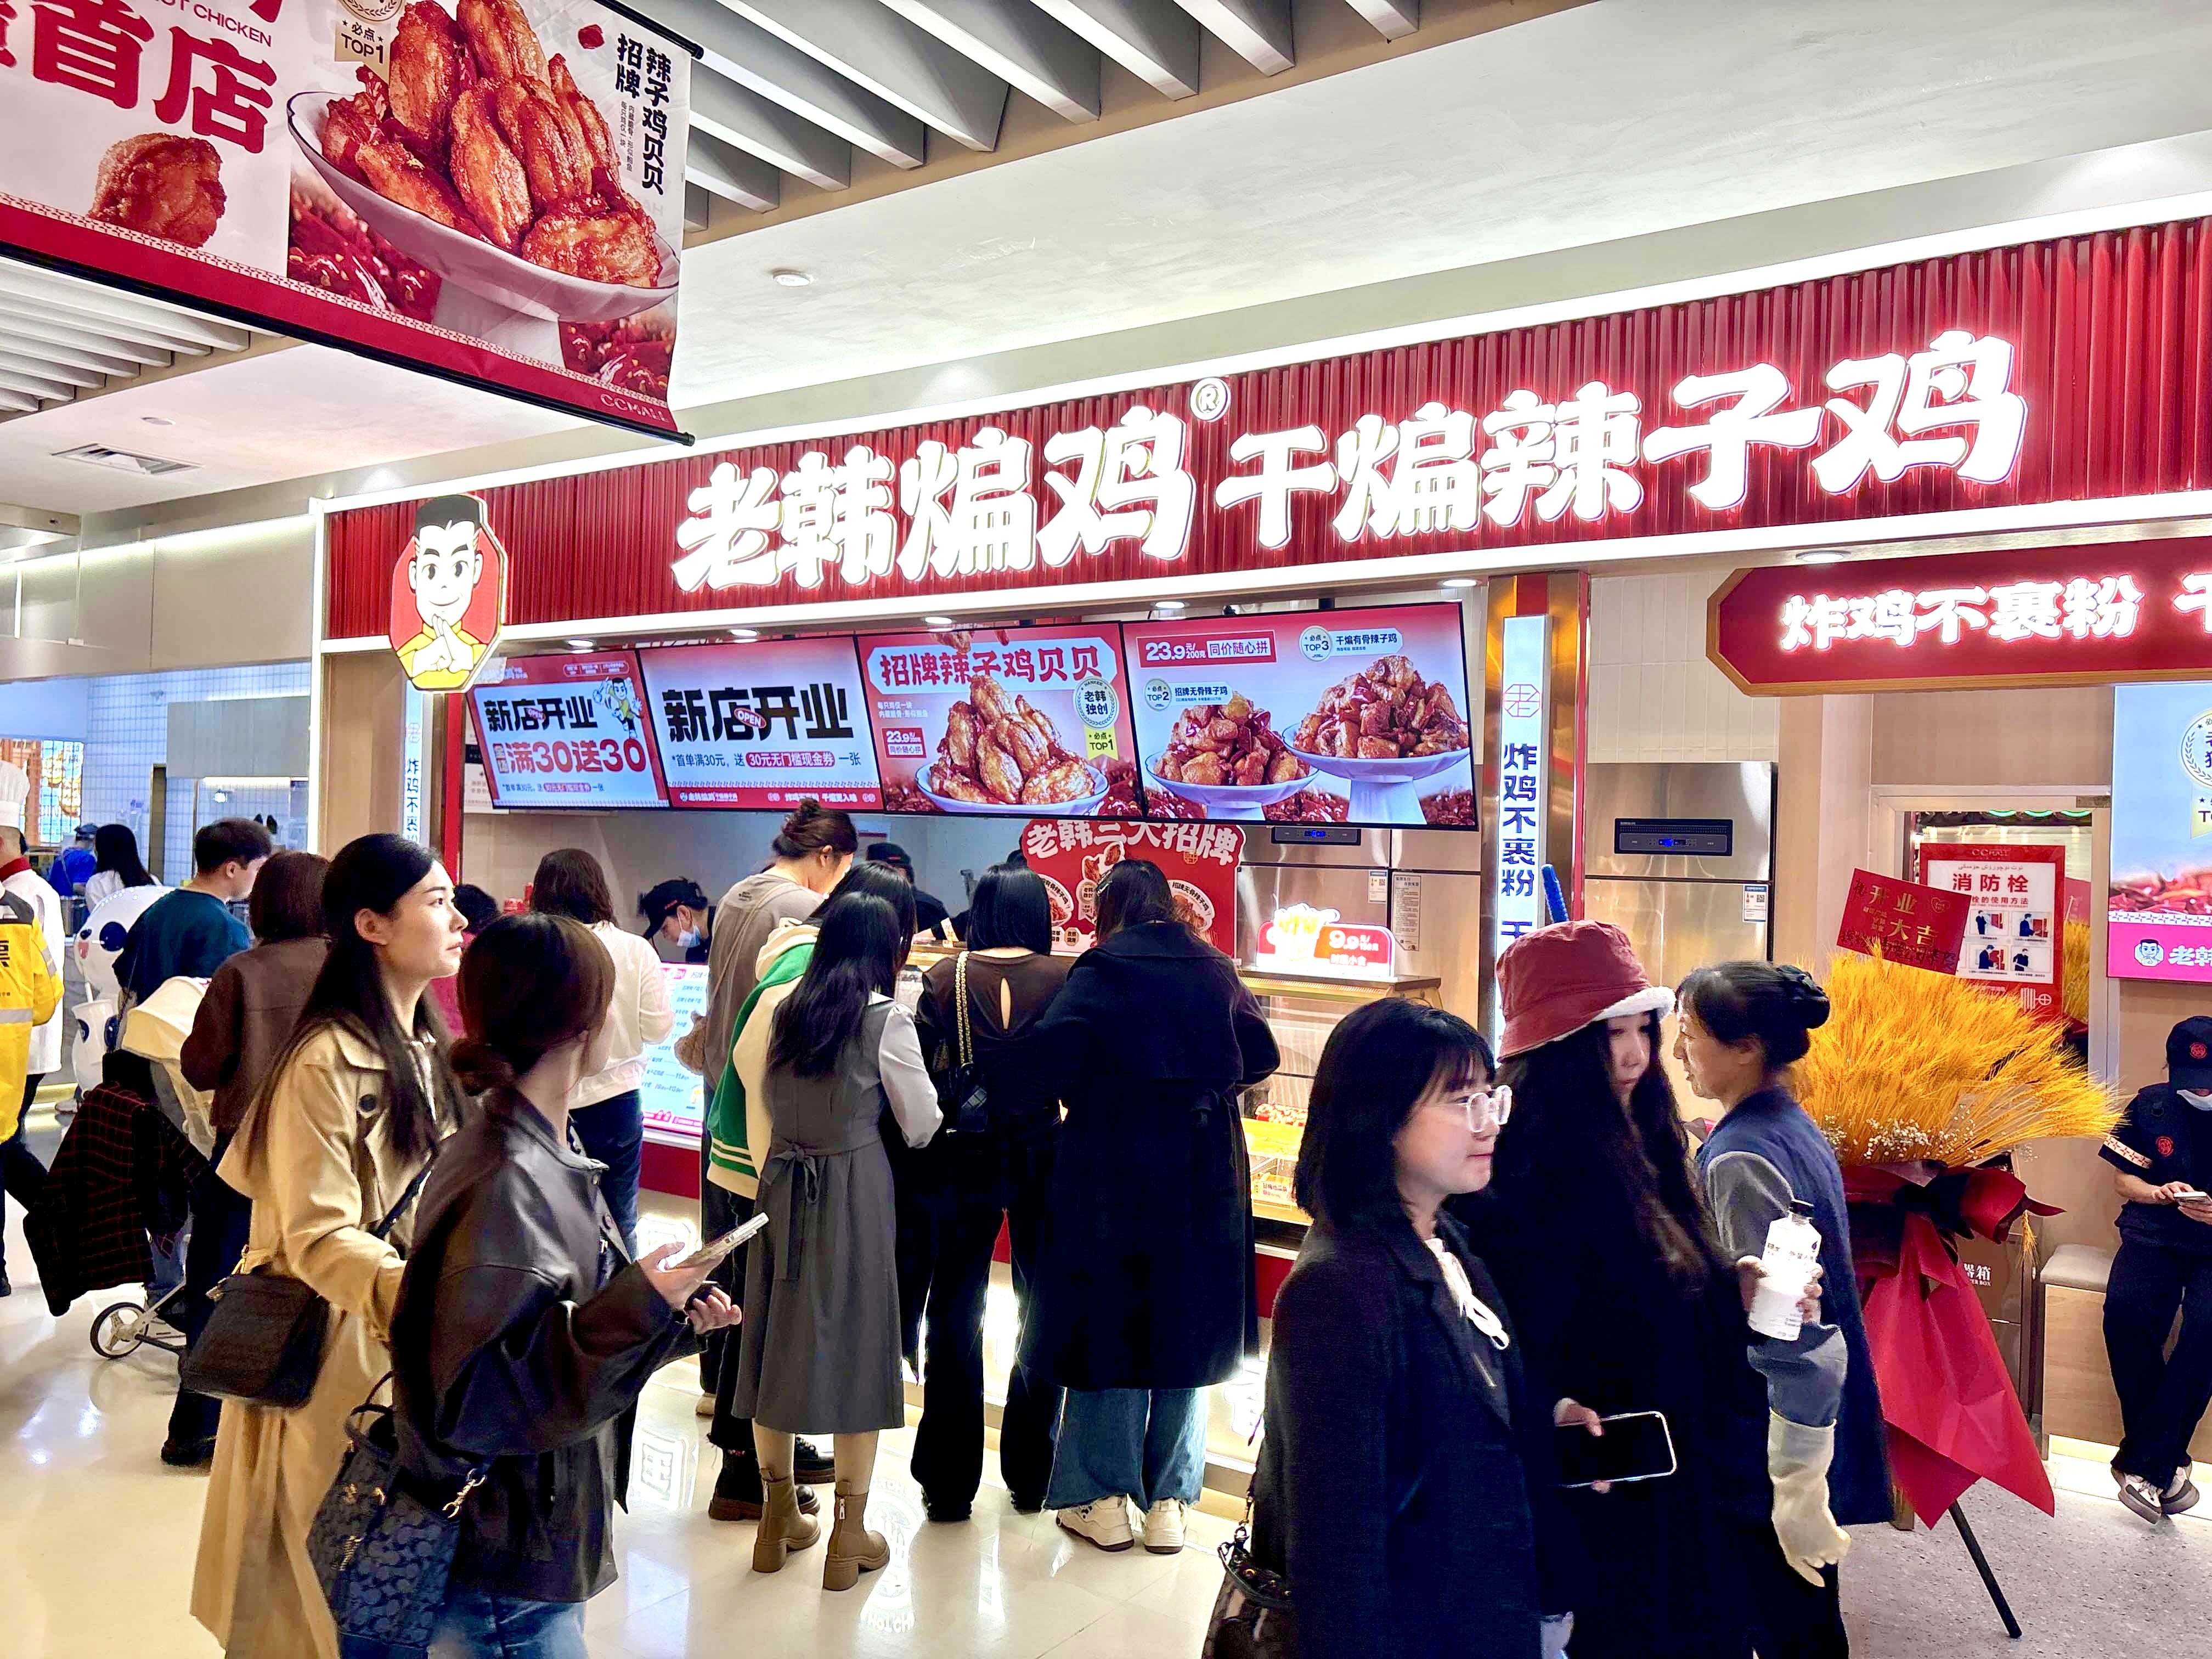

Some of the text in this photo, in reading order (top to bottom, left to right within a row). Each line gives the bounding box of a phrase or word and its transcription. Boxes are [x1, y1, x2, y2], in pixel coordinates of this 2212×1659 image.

[193, 3, 272, 47] CHICKEN
[352, 21, 375, 42] 必点
[341, 33, 384, 64] TOP1
[0, 0, 276, 154] 首店
[616, 33, 643, 98] 招牌
[642, 47, 671, 195] 辣子鸡贝贝
[600, 394, 669, 422] CCMALL
[1215, 329, 2028, 548] 干煸辣子鸡
[671, 405, 1196, 592] 老韩煸鸡
[1782, 574, 2145, 651] 炸鸡不裹粉
[1146, 641, 1186, 661] 23.9
[1210, 640, 1268, 656] 同价随心拼
[1304, 640, 1329, 651] TOP3
[1336, 633, 1397, 645] 干煸有骨辣子鸡
[879, 646, 1102, 687] 招牌辣子鸡贝贝
[1084, 690, 1106, 702] 老韩
[1147, 691, 1169, 701] TOP2
[1175, 686, 1228, 696] 招牌无骨辣子鸡
[483, 696, 598, 732] 新店开业
[662, 683, 854, 742] 新店开业
[737, 710, 761, 727] OPEN
[1085, 703, 1108, 715] 独创
[887, 731, 910, 743] 23.9
[1090, 739, 1113, 750] TOP1
[505, 738, 646, 773] 满30送30
[1501, 742, 1537, 897] 炸鸡不裹粉
[1953, 873, 2028, 893] 消防栓
[1329, 930, 1359, 950] 9.9
[1887, 918, 1938, 948] 大吉
